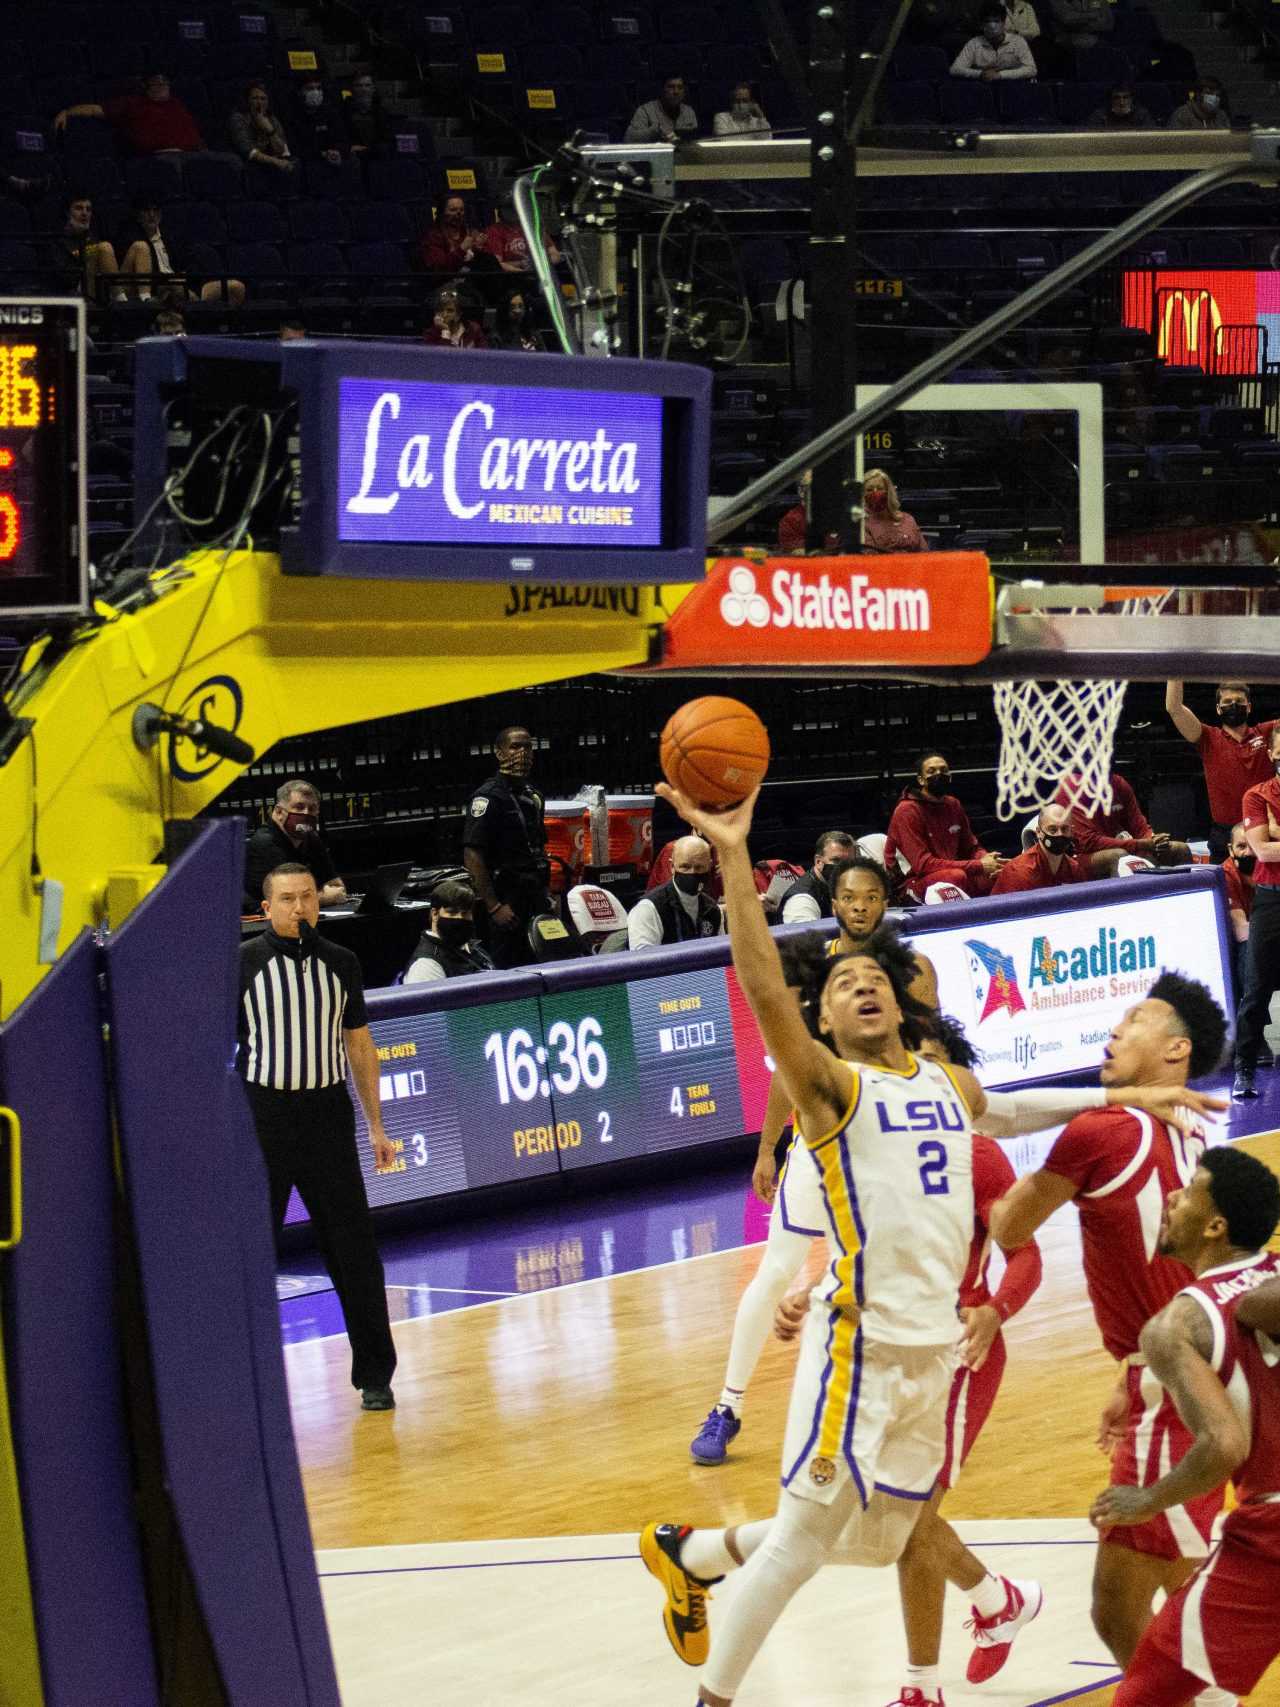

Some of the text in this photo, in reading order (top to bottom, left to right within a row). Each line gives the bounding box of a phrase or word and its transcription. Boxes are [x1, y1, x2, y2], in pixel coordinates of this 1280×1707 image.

[346, 393, 640, 519] La Carreta
[864, 432, 892, 449] 116
[489, 504, 634, 525] MEXICAN CUISINE
[1028, 927, 1156, 988] Acadian
[658, 995, 702, 1015] TIME OUTS
[1031, 982, 1105, 1011] Ambulance
[391, 1043, 417, 1059] OUTS
[485, 1016, 608, 1105] 16:36
[1014, 1033, 1038, 1070] life
[670, 1086, 684, 1118] 4
[686, 1083, 711, 1098] TEAM
[689, 1100, 716, 1117] FOULS
[875, 1101, 965, 1133] LSU
[412, 1132, 428, 1166] 3
[512, 1111, 614, 1158] PERIOD 2
[918, 1141, 950, 1195] 2
